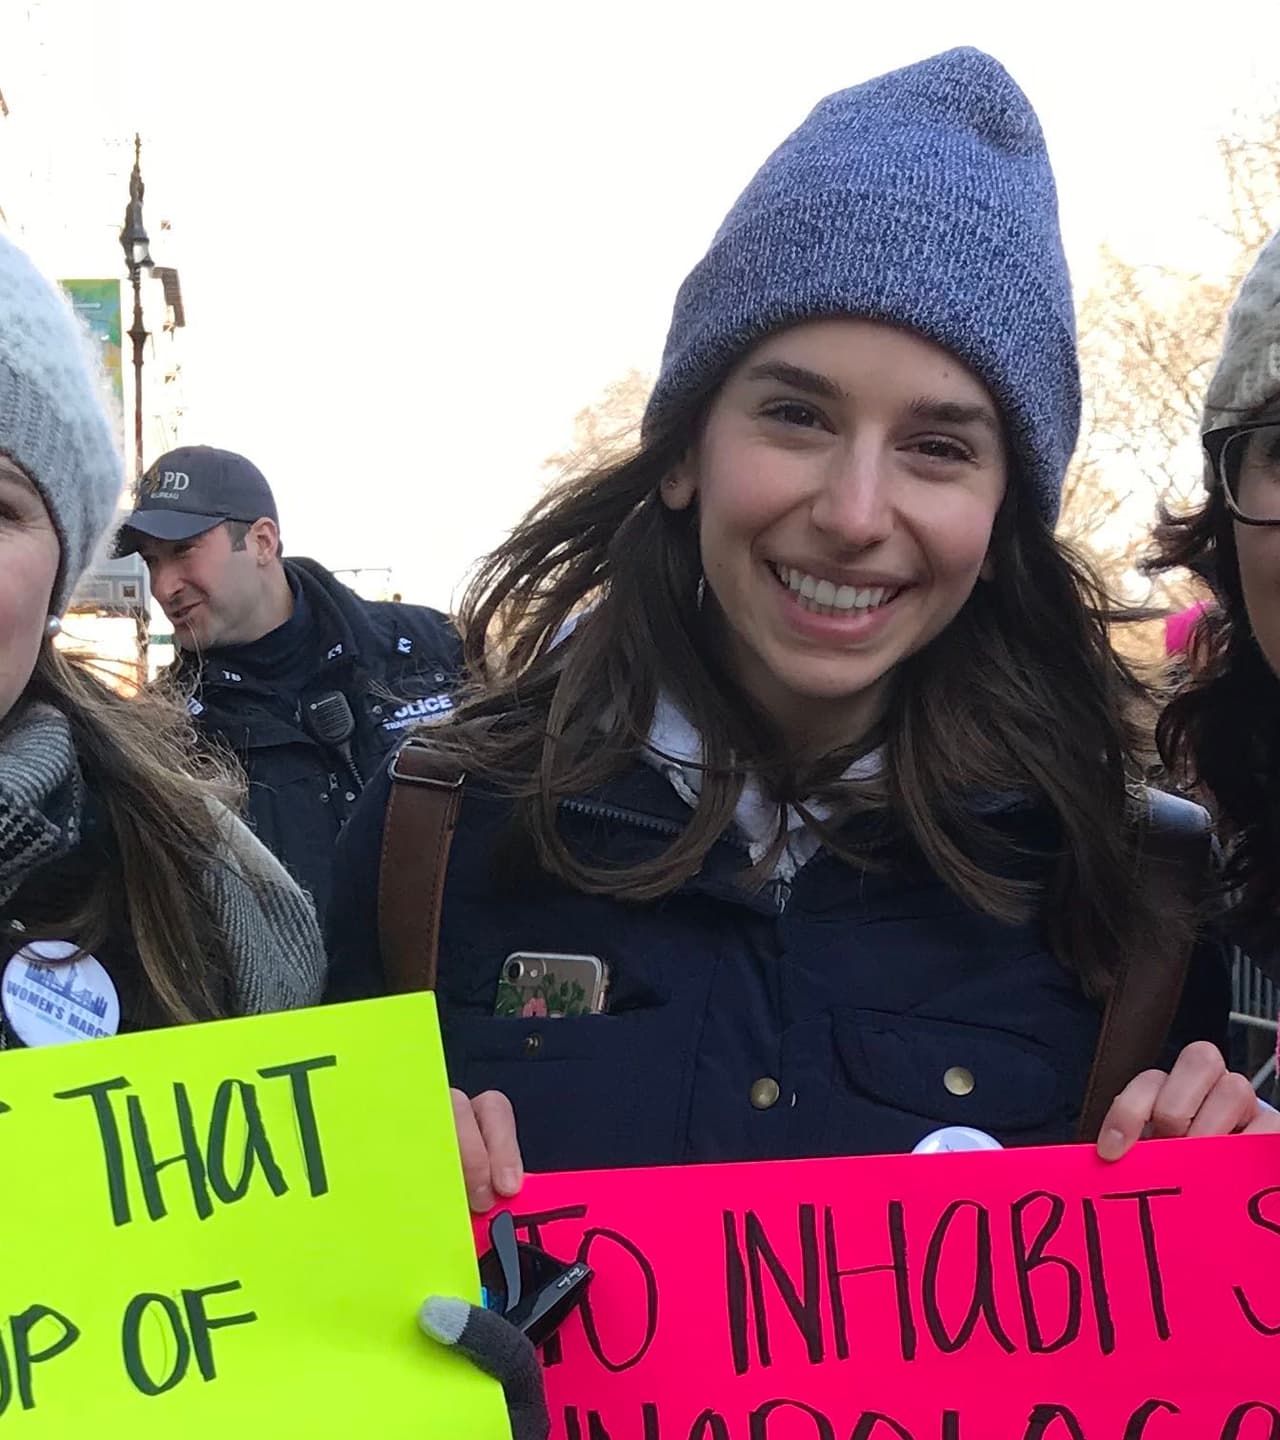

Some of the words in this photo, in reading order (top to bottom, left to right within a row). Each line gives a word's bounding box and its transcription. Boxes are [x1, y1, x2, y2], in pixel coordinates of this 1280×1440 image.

[382, 694, 453, 724] OLICE
[6, 980, 66, 1021] WOMEN'S
[68, 1012, 112, 1039] MARC
[123, 1281, 256, 1396] OF
